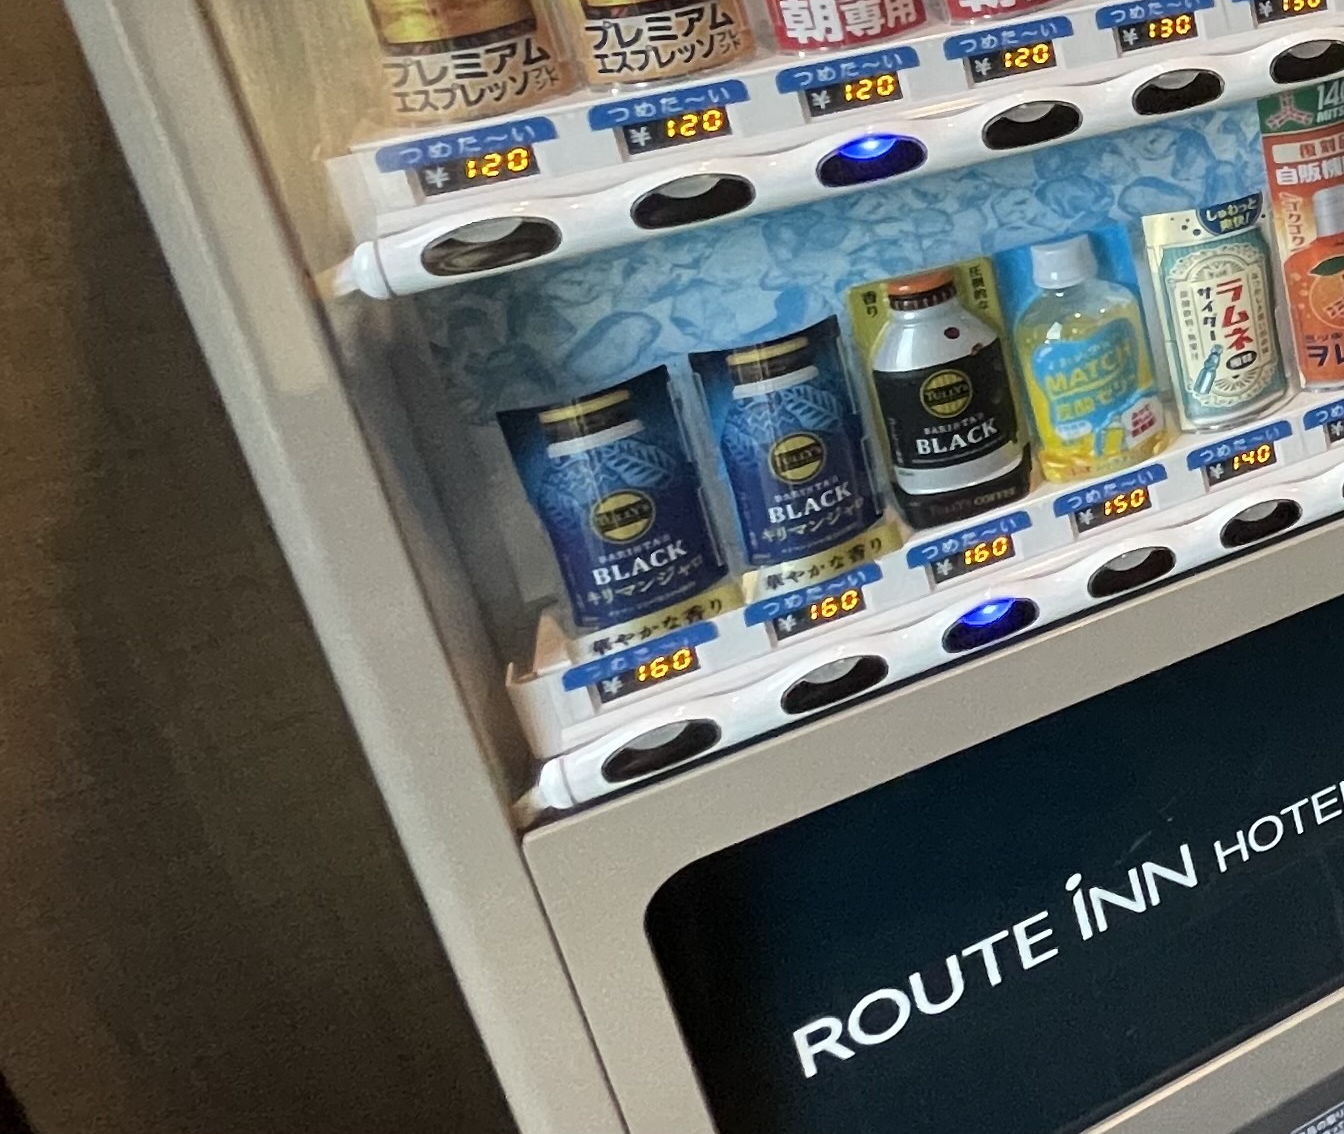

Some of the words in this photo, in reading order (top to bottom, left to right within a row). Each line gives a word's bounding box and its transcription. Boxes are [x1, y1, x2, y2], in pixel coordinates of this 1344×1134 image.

[584, 1, 735, 52] プレミアム
[1149, 15, 1192, 37] 130
[383, 39, 552, 89] プレミアム
[598, 34, 717, 75] エスプレッソ
[1004, 45, 1051, 68] 120
[395, 72, 533, 114] エスプレッソ
[845, 74, 895, 101] 120
[667, 109, 723, 137] 120
[467, 148, 529, 178] 120
[1206, 197, 1258, 222] しゅわっと
[1197, 286, 1217, 342] サイダー
[1215, 278, 1254, 351] ラムネ
[915, 418, 998, 456] BLACK
[1232, 445, 1271, 470] 140
[768, 484, 853, 524] BLACK
[1104, 489, 1146, 515] 150
[591, 539, 688, 587] BLACK
[964, 537, 1009, 565] 160
[810, 590, 860, 620] 160
[636, 648, 693, 682] 160
[793, 910, 1059, 1078] ROUTE
